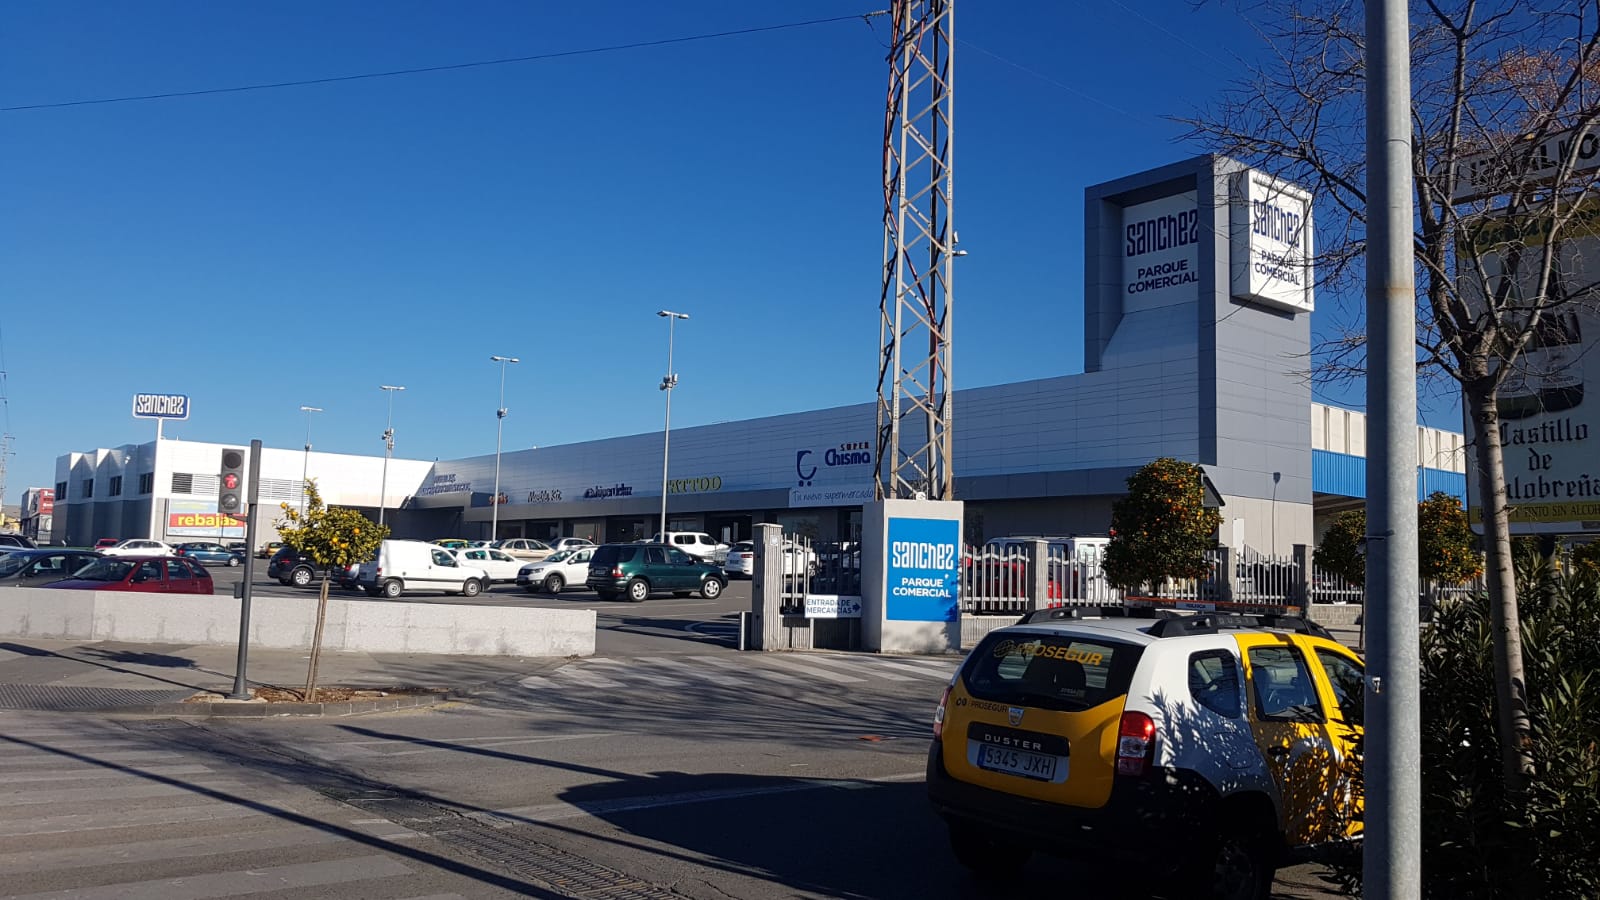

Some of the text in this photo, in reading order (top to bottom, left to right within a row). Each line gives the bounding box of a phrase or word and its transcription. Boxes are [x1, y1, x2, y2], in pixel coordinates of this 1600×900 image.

[1137, 259, 1188, 279] PARQUE
[1261, 250, 1296, 270] PARQUE
[1127, 270, 1199, 294] COMERCIAL
[1254, 262, 1301, 286] COMERCIAL
[840, 441, 870, 451] SUPER
[825, 448, 871, 466] Chisma
[1528, 447, 1552, 471] de
[1505, 473, 1600, 500] alobreña
[1552, 505, 1567, 517] SIN
[177, 513, 238, 528] rebajas
[901, 577, 945, 588] PARQUE
[806, 598, 839, 606] ENTRADA
[892, 587, 952, 599] COMERCIAL
[1016, 642, 1103, 666] PROSEGUR
[970, 700, 1007, 713] PROSEGUR
[984, 733, 1042, 751] DUSTER
[986, 749, 1051, 775] 5345 JXH
